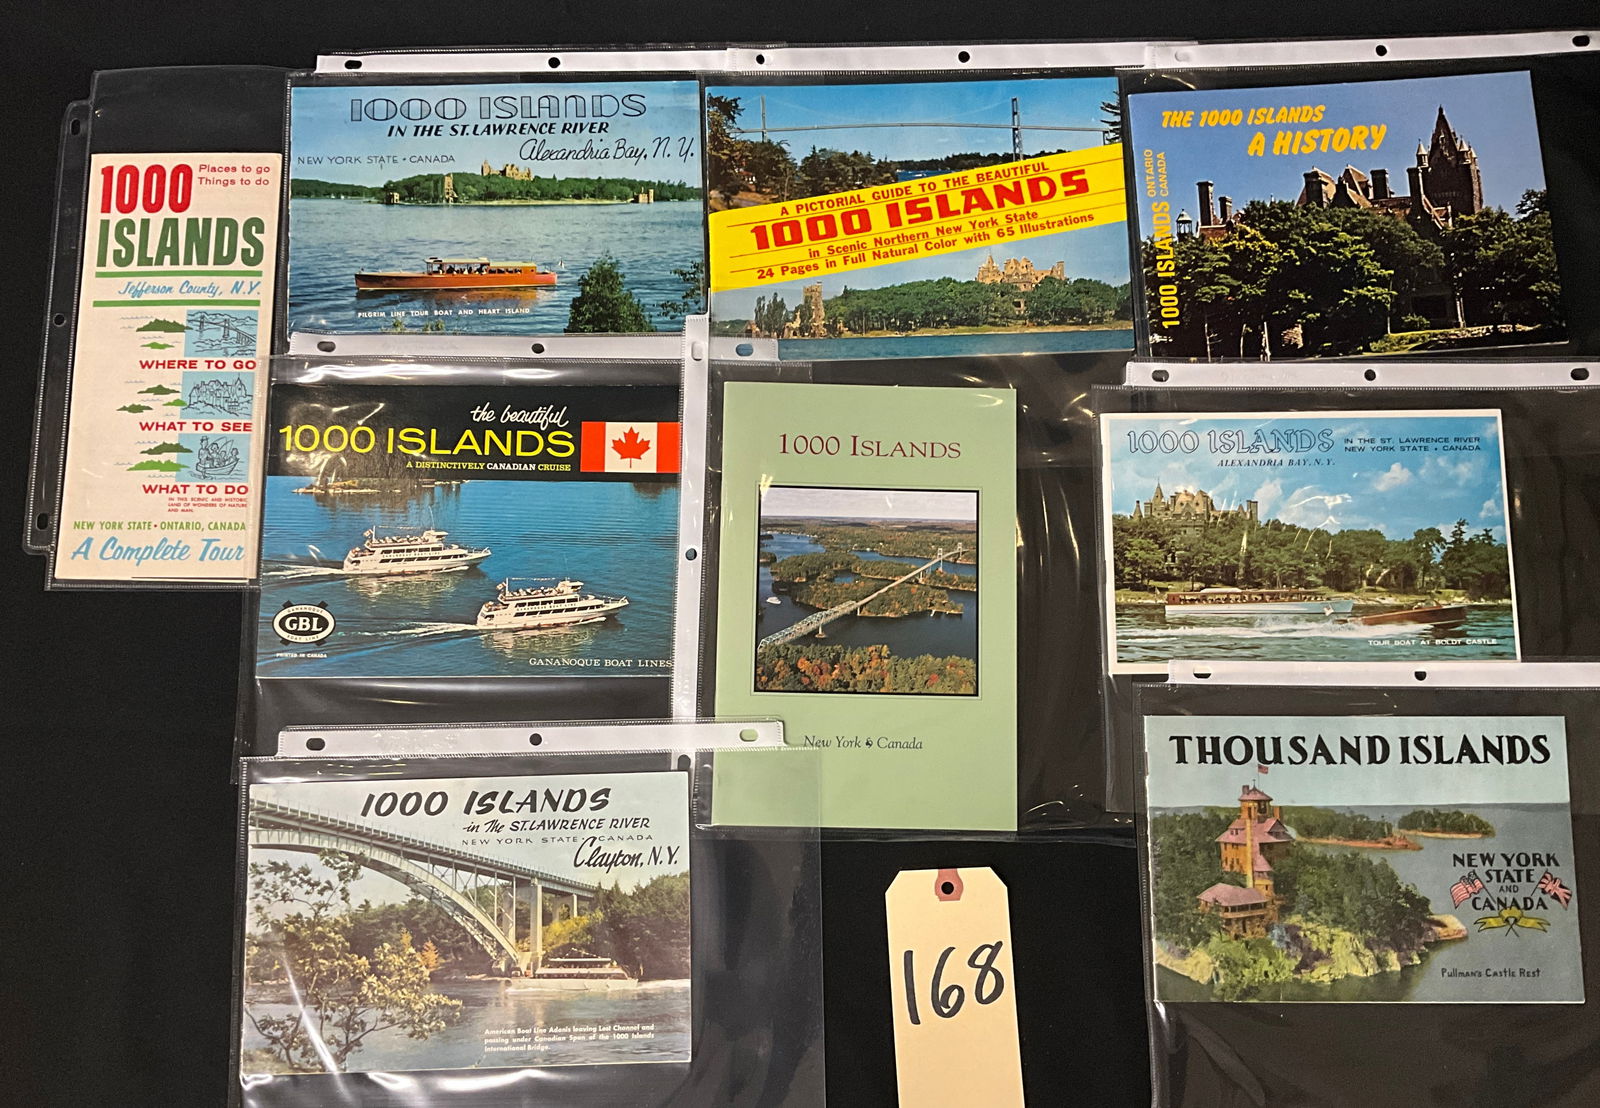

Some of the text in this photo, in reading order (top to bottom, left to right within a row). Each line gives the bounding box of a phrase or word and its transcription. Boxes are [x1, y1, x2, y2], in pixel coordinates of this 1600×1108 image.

[351, 93, 647, 122] 1000 ISLANDS
[1161, 104, 1326, 128] THE 1000 ISLANDS
[387, 121, 610, 137] IN THE RIVER
[1247, 123, 1387, 156] A HISTORY
[297, 154, 455, 165] NEW YORK STATE CANADA
[519, 138, 648, 165] Alexandria Bay,
[199, 164, 271, 175] Places to go
[1143, 149, 1156, 197] ONTARIO
[1157, 152, 1169, 197] CANADA
[100, 164, 193, 214] 1000
[198, 176, 270, 187] Things to do
[780, 162, 1049, 216] A PICTORIAL GUIDE TO THE BEAUTIFUL
[750, 169, 1089, 250] 1000 ISLANDS
[96, 217, 264, 267] ISLANDS
[808, 210, 1038, 258] in Scenic Northern New York State
[756, 213, 1094, 279] 24 Pages in Full Natural Color with 65 Illustrations
[1152, 201, 1180, 329] 1000 ISLANDS
[118, 281, 173, 298] Jefferson
[179, 280, 223, 298] County,
[139, 359, 257, 370] WHERE TO GO
[139, 421, 253, 432] WHAT TO SEE
[470, 402, 569, 431] the beautiful
[279, 424, 575, 457] 1000 ISLANDS
[779, 433, 840, 456] 1000
[1127, 428, 1335, 454] 1000 ISLANDS
[415, 461, 485, 470] DISTINCTIVELY
[486, 462, 536, 471] CANADIAN
[538, 463, 571, 471] CRUISE
[1217, 459, 1283, 467] ALEXANDRIA
[142, 484, 249, 495] WHAT TO DO
[73, 521, 246, 532] NEW YORK STATE ONTARIO, CANADA
[70, 535, 246, 567] A Complete Tour
[284, 616, 323, 632] GBL
[529, 657, 673, 667] GANANOQUE BOAT LINES
[803, 735, 923, 749] New York Canada
[1168, 734, 1551, 766] THOUSAND ISLANDS
[360, 787, 612, 817] 1000 ISLANDS
[483, 817, 650, 833] The RIVER
[462, 838, 491, 846] NEW
[496, 837, 533, 845] YORK
[598, 834, 653, 842] CANADA
[573, 836, 644, 874] Clayton,
[1452, 852, 1560, 867] NEW YORK
[1485, 868, 1535, 883] STATE
[1498, 884, 1519, 893] AND
[1471, 896, 1549, 911] CANADA
[903, 940, 1005, 1025] 168
[484, 1044, 526, 1052] International
[569, 1034, 586, 1042] Span
